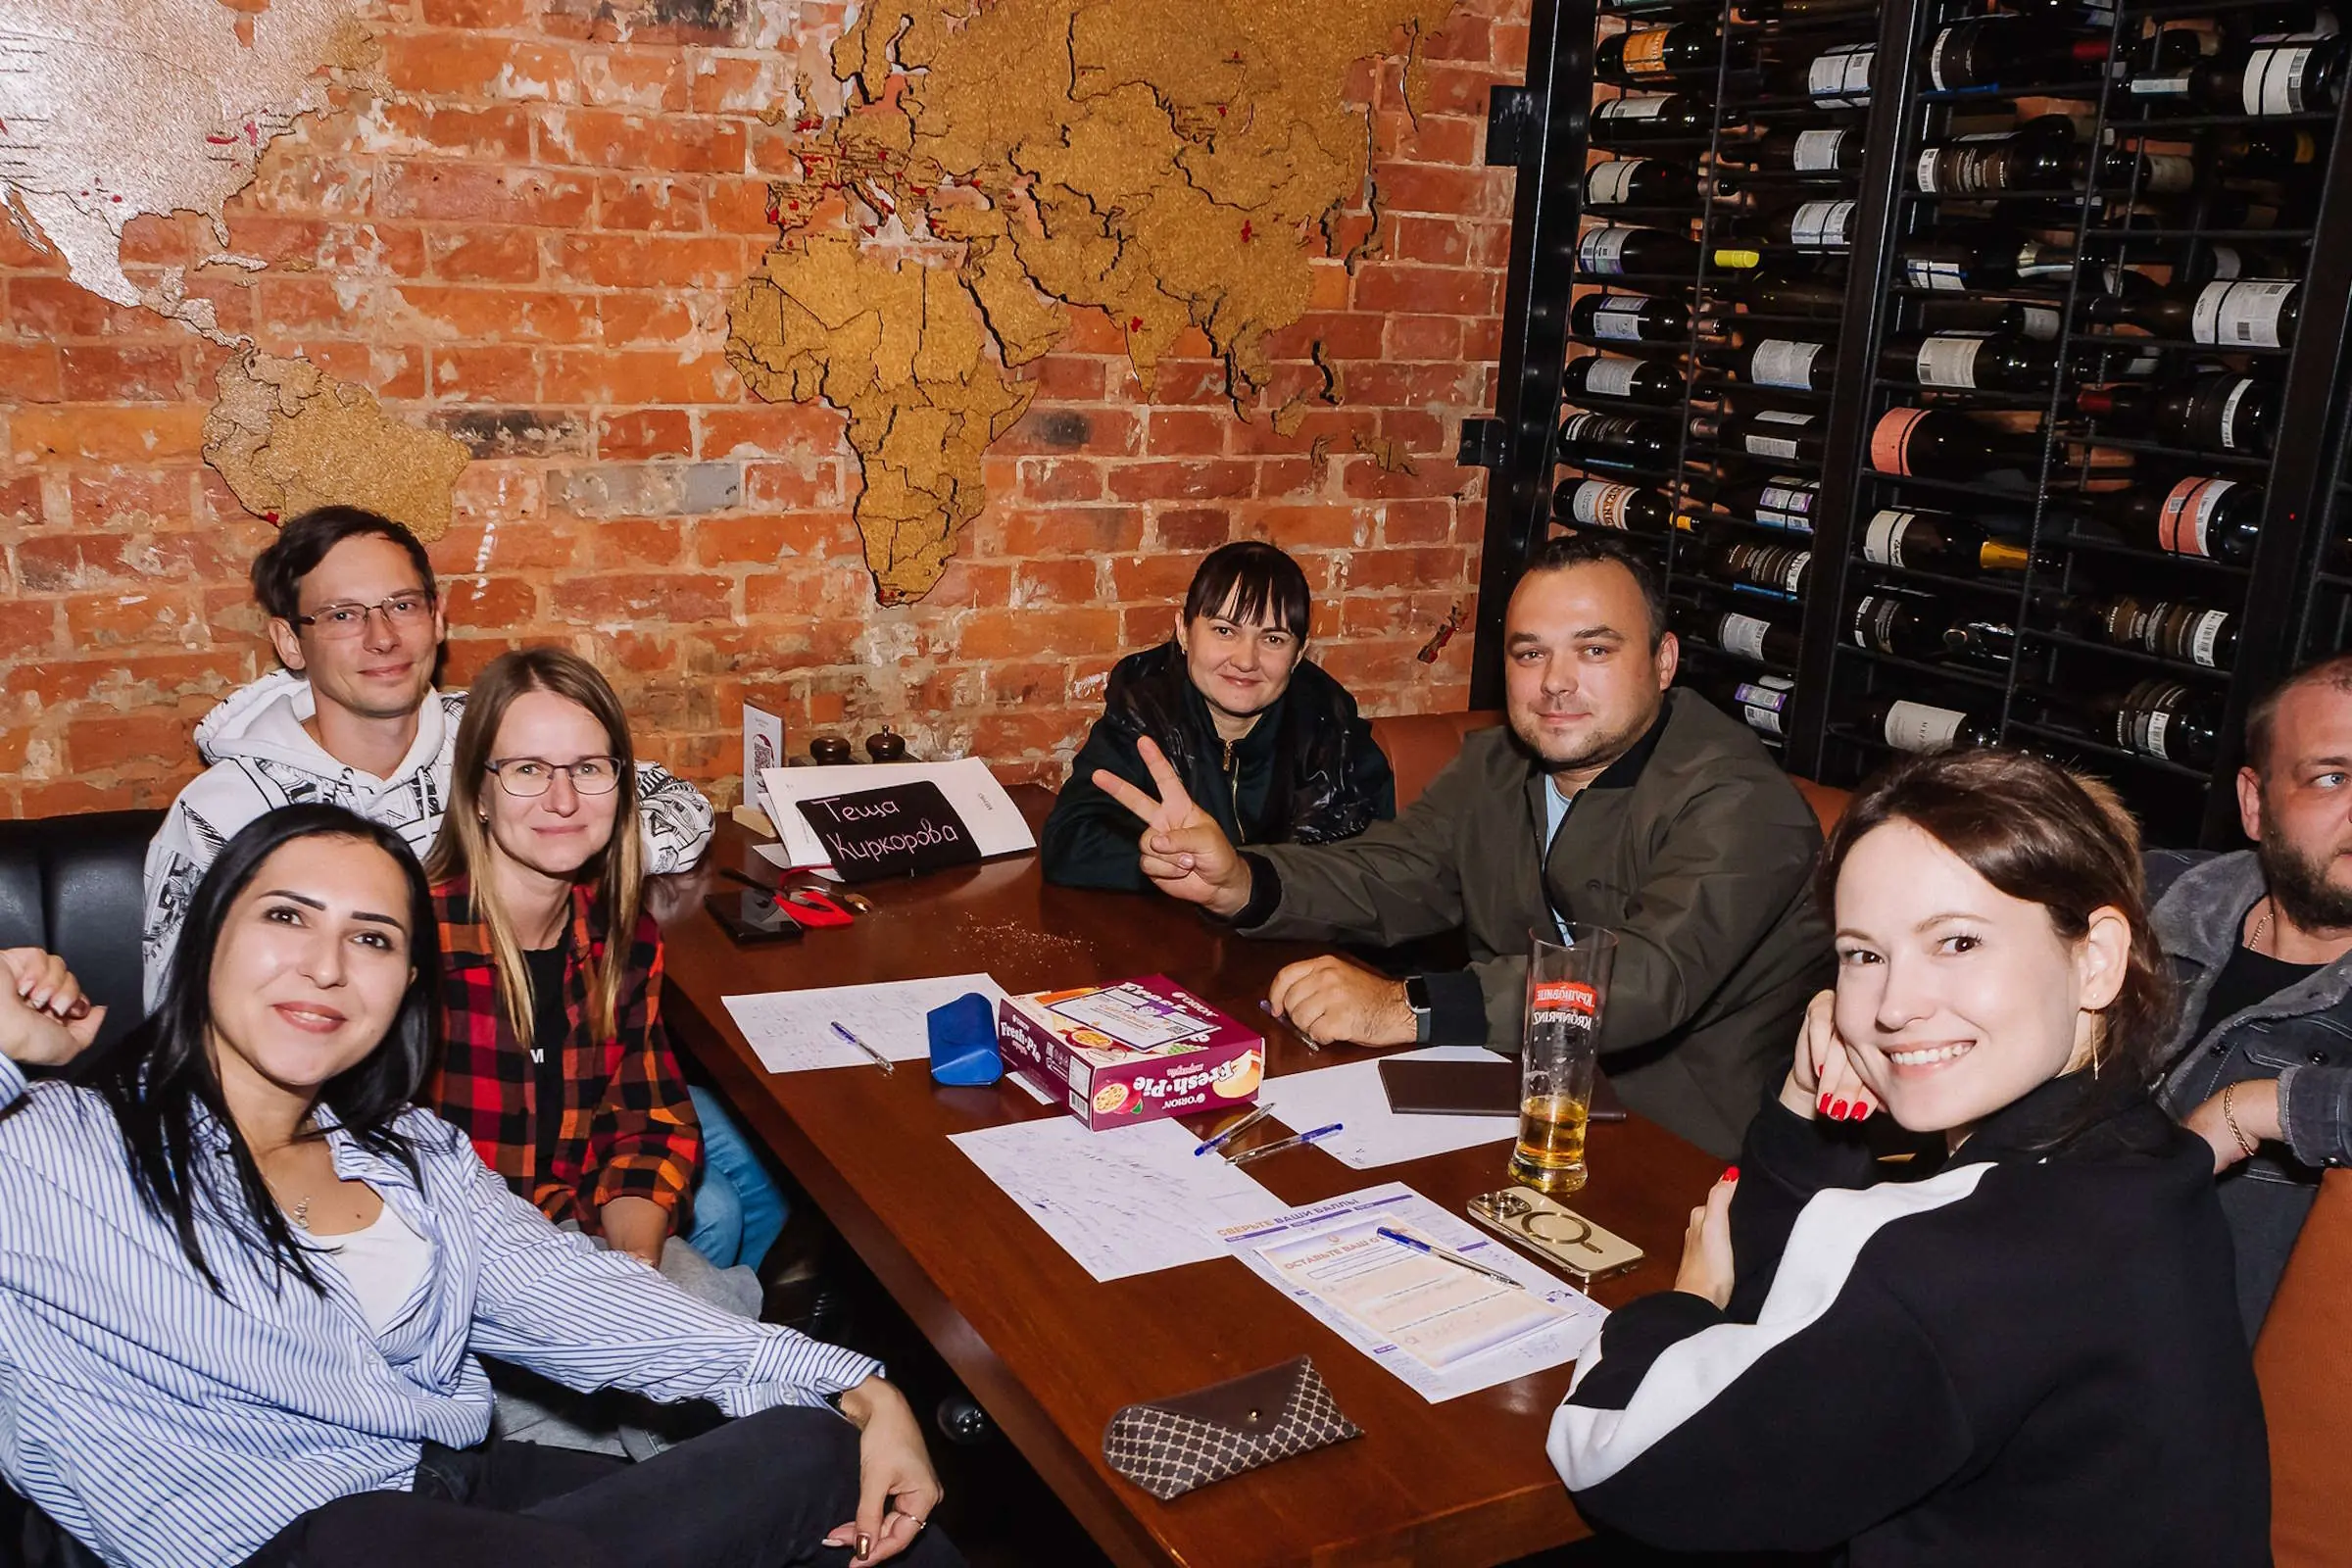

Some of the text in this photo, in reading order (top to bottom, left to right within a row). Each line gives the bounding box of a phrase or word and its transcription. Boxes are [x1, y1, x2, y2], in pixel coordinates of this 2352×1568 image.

[810, 797, 901, 823] Теща
[826, 817, 958, 862] Киркорова
[1162, 1096, 1196, 1109] ORION
[1216, 1219, 1273, 1236] СВЕРЬТЕ
[1274, 1208, 1313, 1223] ВАШИ
[1314, 1198, 1357, 1213] БАЛЛЫ
[1284, 1238, 1369, 1270] ОСТАВЬТЕ ВАШ
